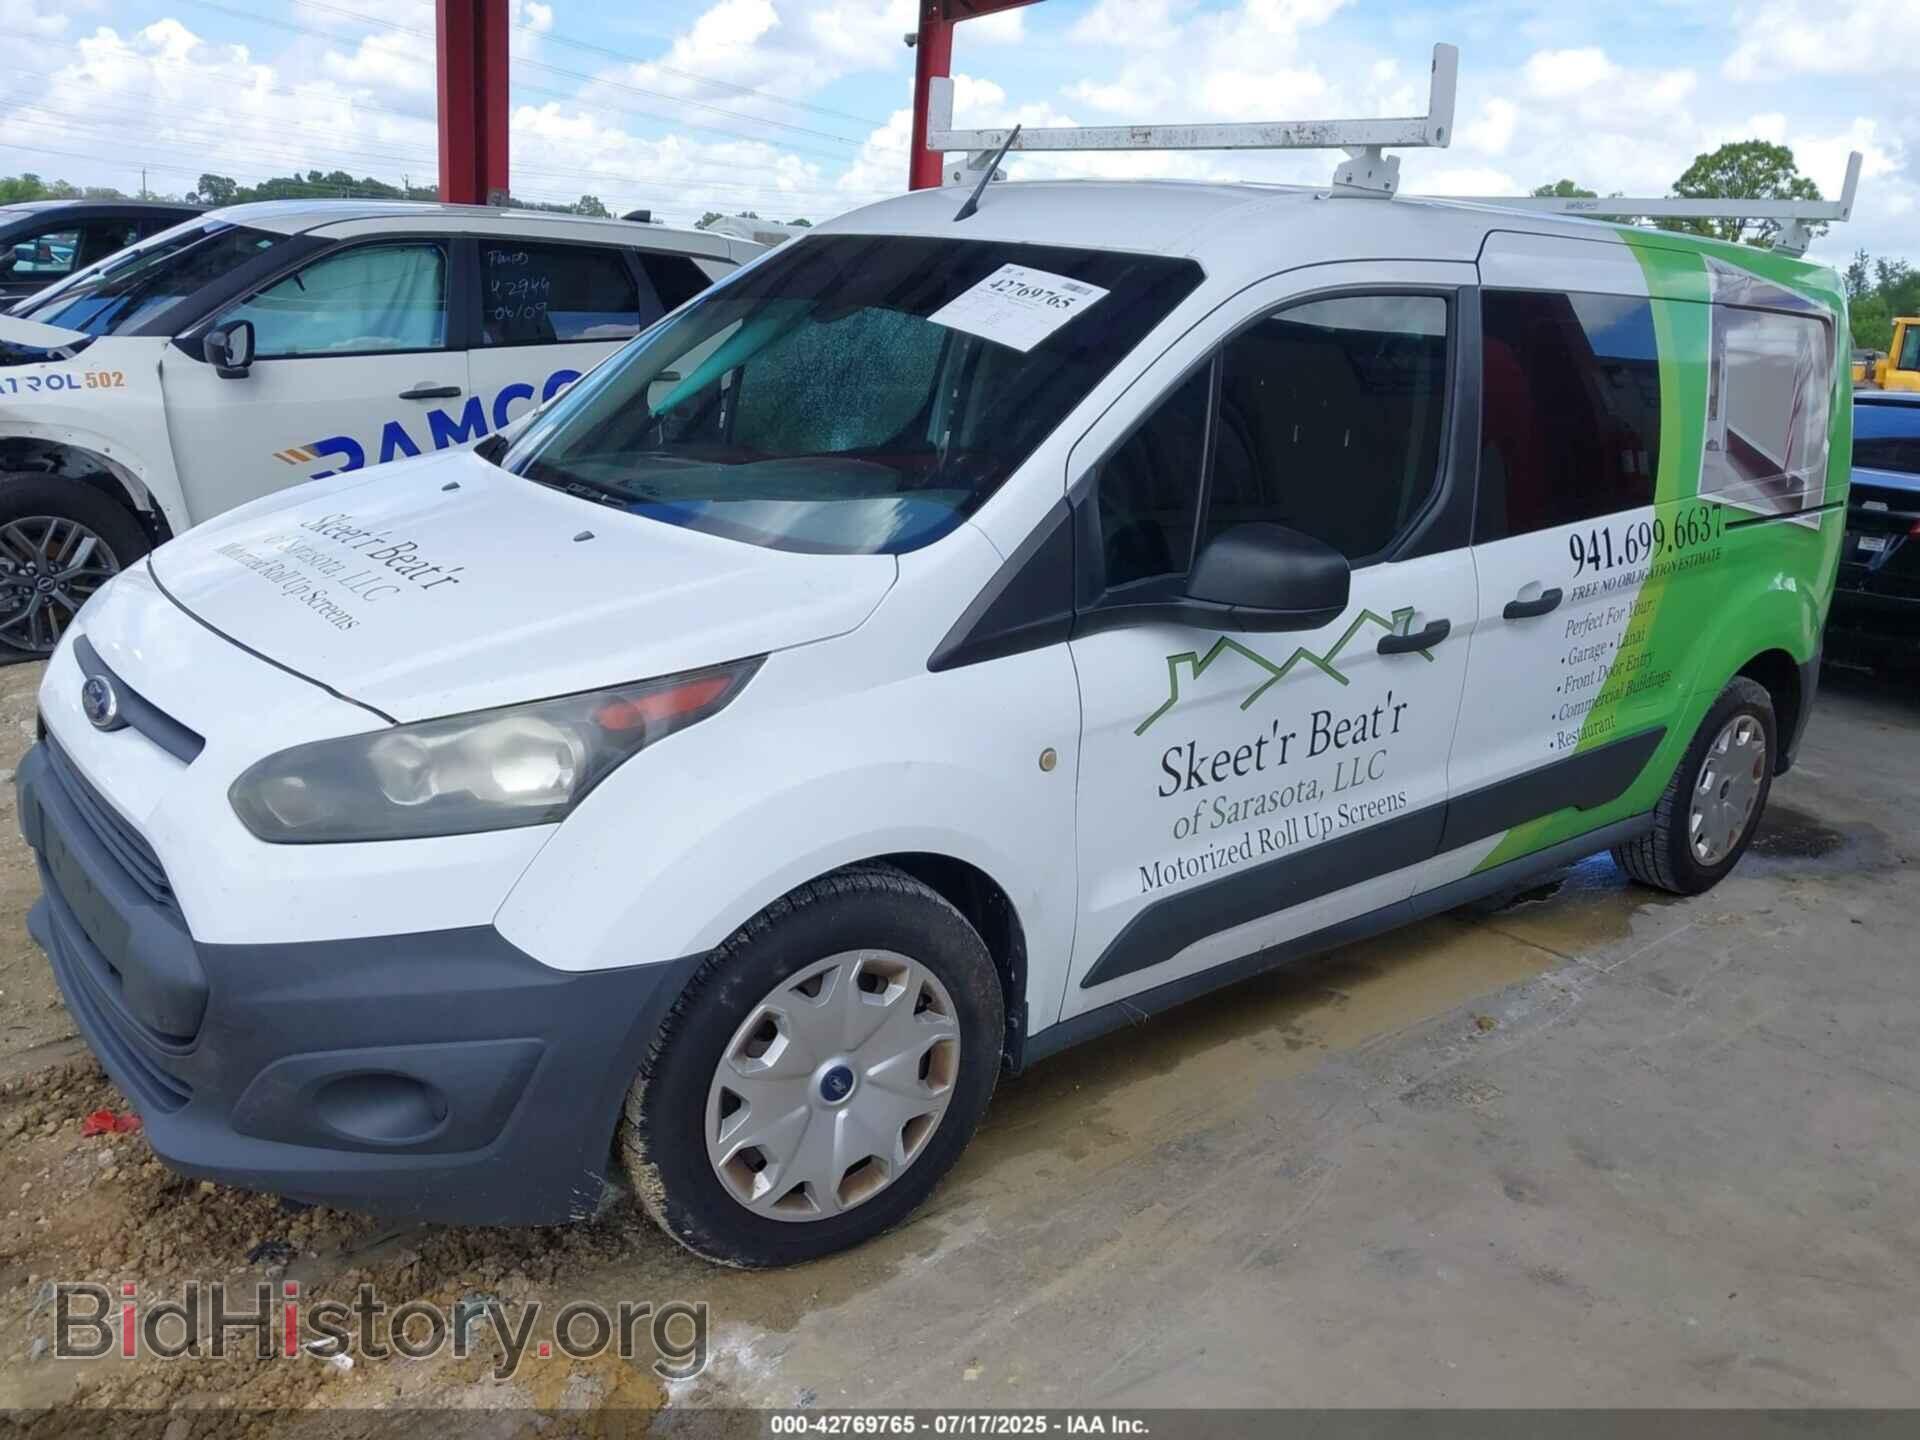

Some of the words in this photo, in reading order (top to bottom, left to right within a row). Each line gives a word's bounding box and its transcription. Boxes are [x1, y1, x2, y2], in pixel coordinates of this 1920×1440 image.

[989, 278, 1077, 309] 42769765
[85, 371, 126, 389] 502
[300, 513, 392, 550] Skeet'r
[366, 540, 464, 591] Beat'r
[1569, 503, 1723, 578] 941.699.6637
[338, 570, 400, 602] LLC
[1571, 581, 1601, 601] FREE
[1600, 576, 1617, 593] NO
[1617, 559, 1680, 587] OBLIGATION
[1678, 547, 1722, 573] ESTIMATE
[281, 574, 313, 599] Up
[307, 589, 360, 631] Screens
[1565, 611, 1604, 638] Perfect
[1606, 606, 1626, 626] For
[1568, 640, 1607, 666] Garage
[1564, 670, 1597, 694] Front
[1597, 662, 1624, 682] Door
[1559, 688, 1625, 721] Commercial
[1158, 719, 1296, 797] Skeet'r
[1306, 690, 1407, 758] Beat'r
[1556, 715, 1616, 750] Restaurant
[1173, 799, 1207, 839] of
[1210, 778, 1324, 829] Sarasota,
[1334, 749, 1387, 793] LLC
[1138, 832, 1253, 893] Motorized
[1257, 817, 1300, 855] Roll
[1304, 812, 1333, 840] Up
[1338, 790, 1407, 828] Screens
